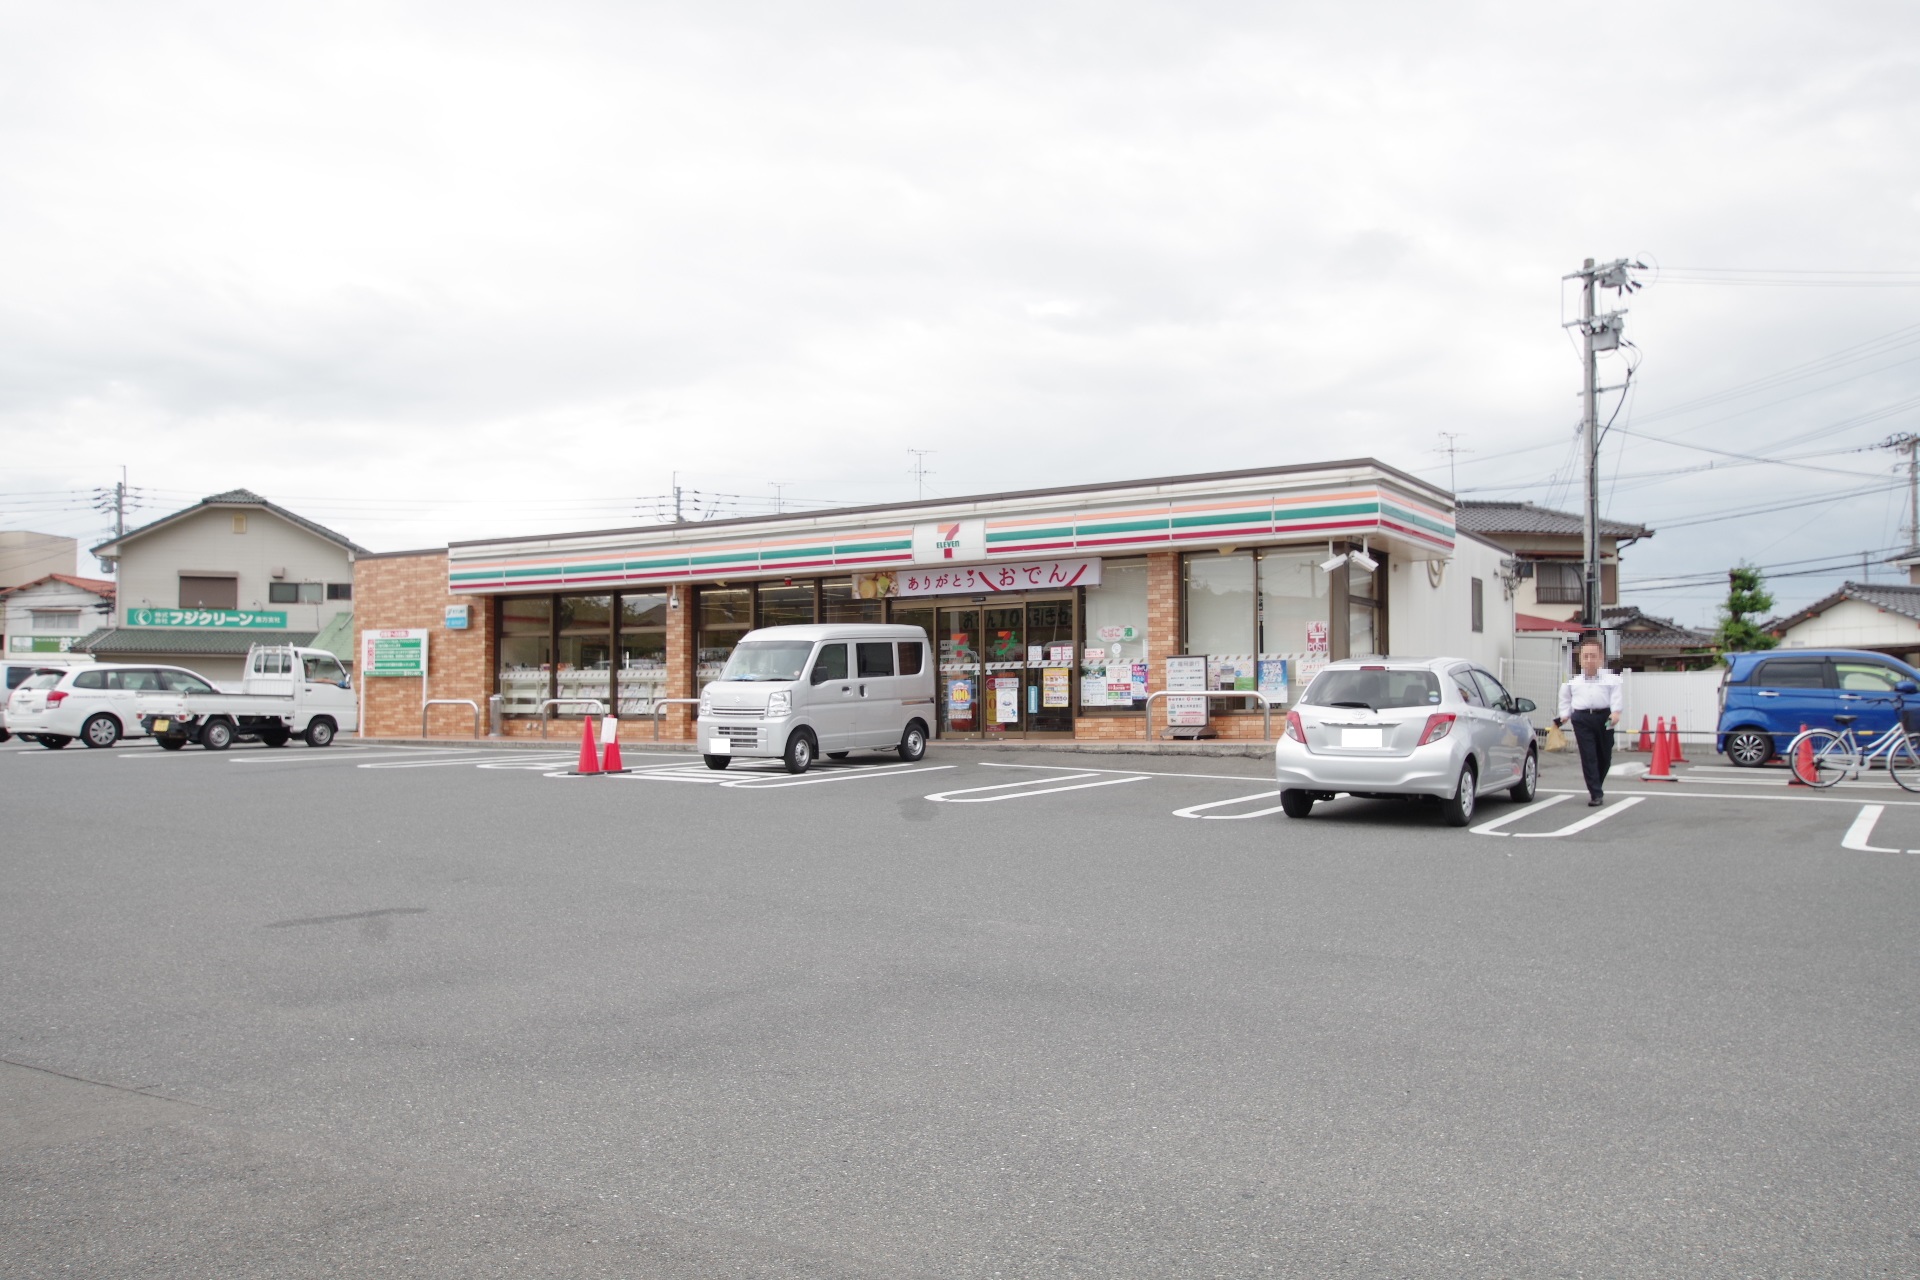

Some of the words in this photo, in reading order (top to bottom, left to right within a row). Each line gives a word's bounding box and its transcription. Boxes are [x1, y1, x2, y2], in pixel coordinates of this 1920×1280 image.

[907, 573, 975, 591] ありがとう
[999, 563, 1068, 587] おでん
[170, 611, 254, 626] フジクリーン
[1101, 628, 1120, 638] たばこ
[1124, 627, 1133, 637] 酒
[1308, 642, 1327, 651] POST
